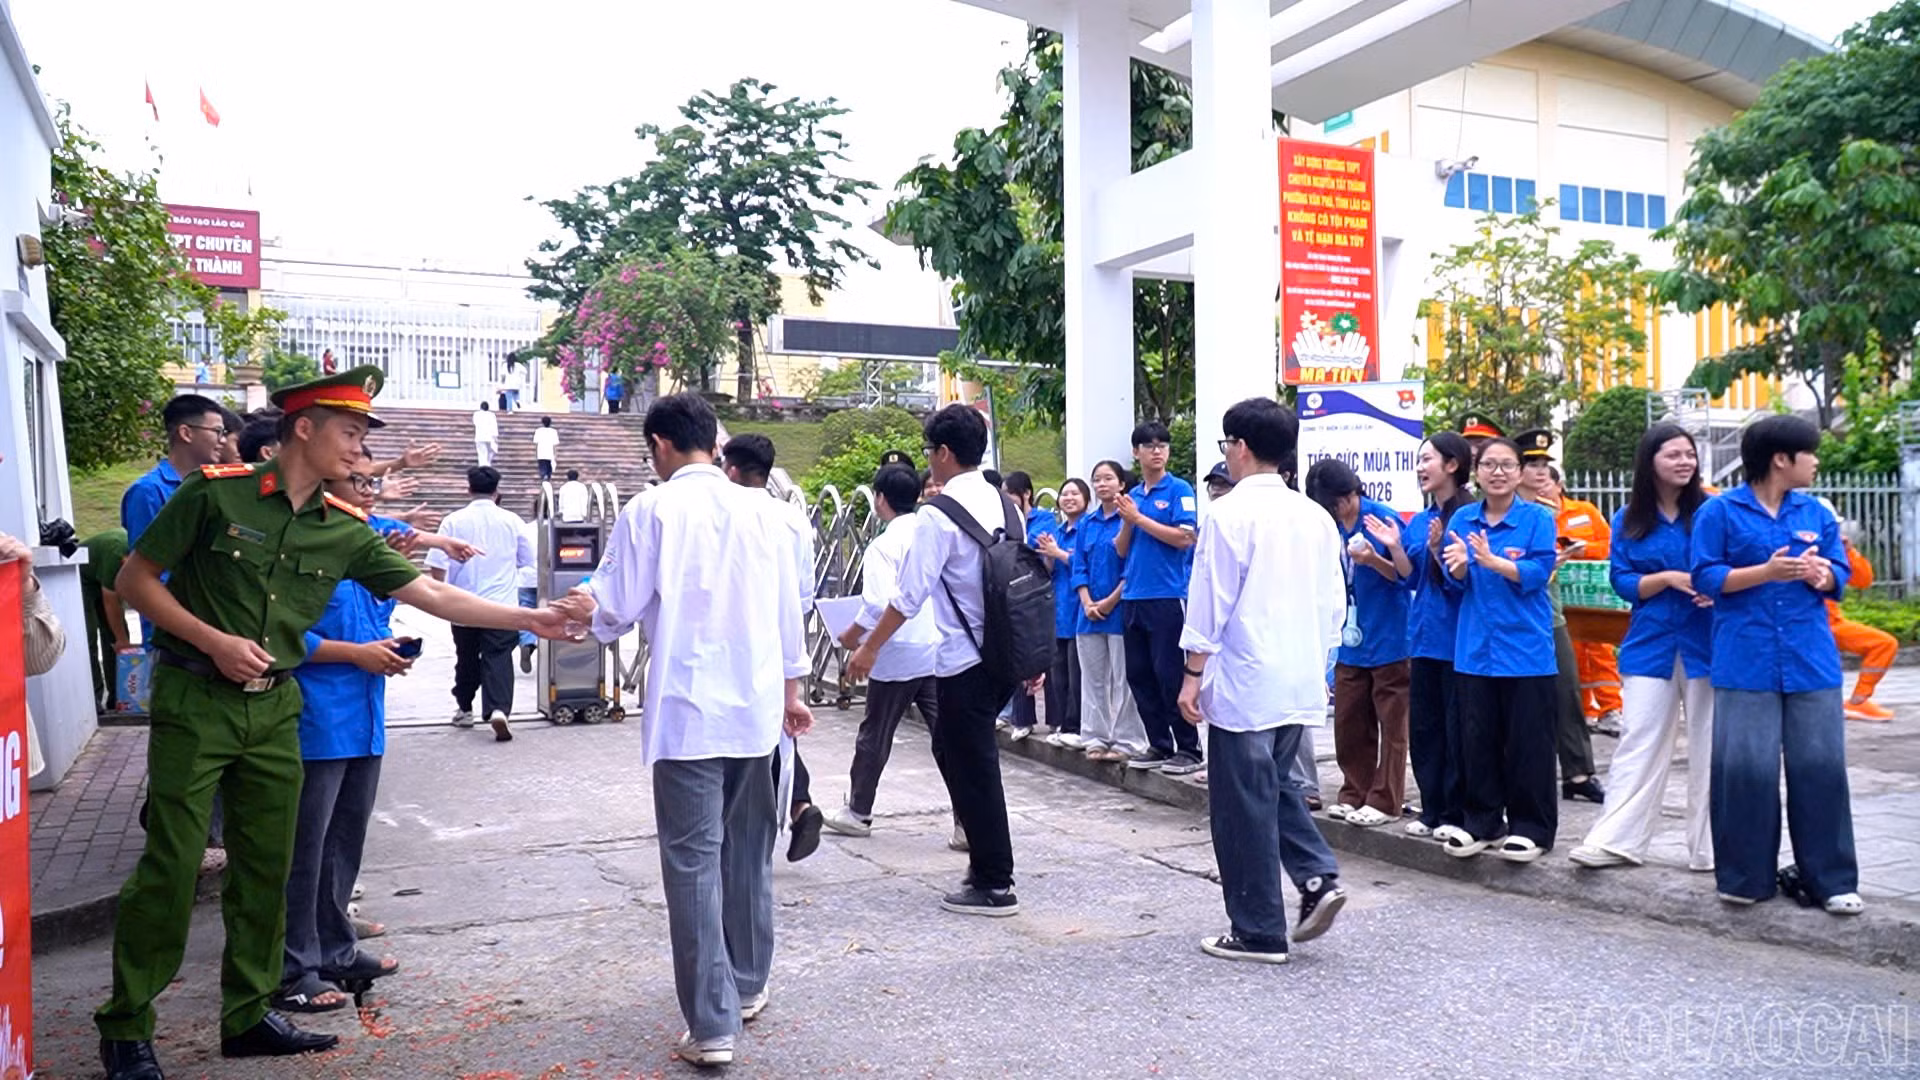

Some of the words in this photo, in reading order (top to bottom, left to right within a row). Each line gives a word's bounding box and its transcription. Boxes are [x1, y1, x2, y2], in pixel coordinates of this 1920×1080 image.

[1287, 209, 1316, 224] KHÔNG
[1344, 216, 1368, 230] PHẠM
[195, 235, 253, 254] CHUYÊN
[195, 255, 243, 275] THÀNH
[1300, 367, 1326, 383] MA
[1364, 448, 1391, 472] MÙA
[1395, 451, 1413, 471] THI
